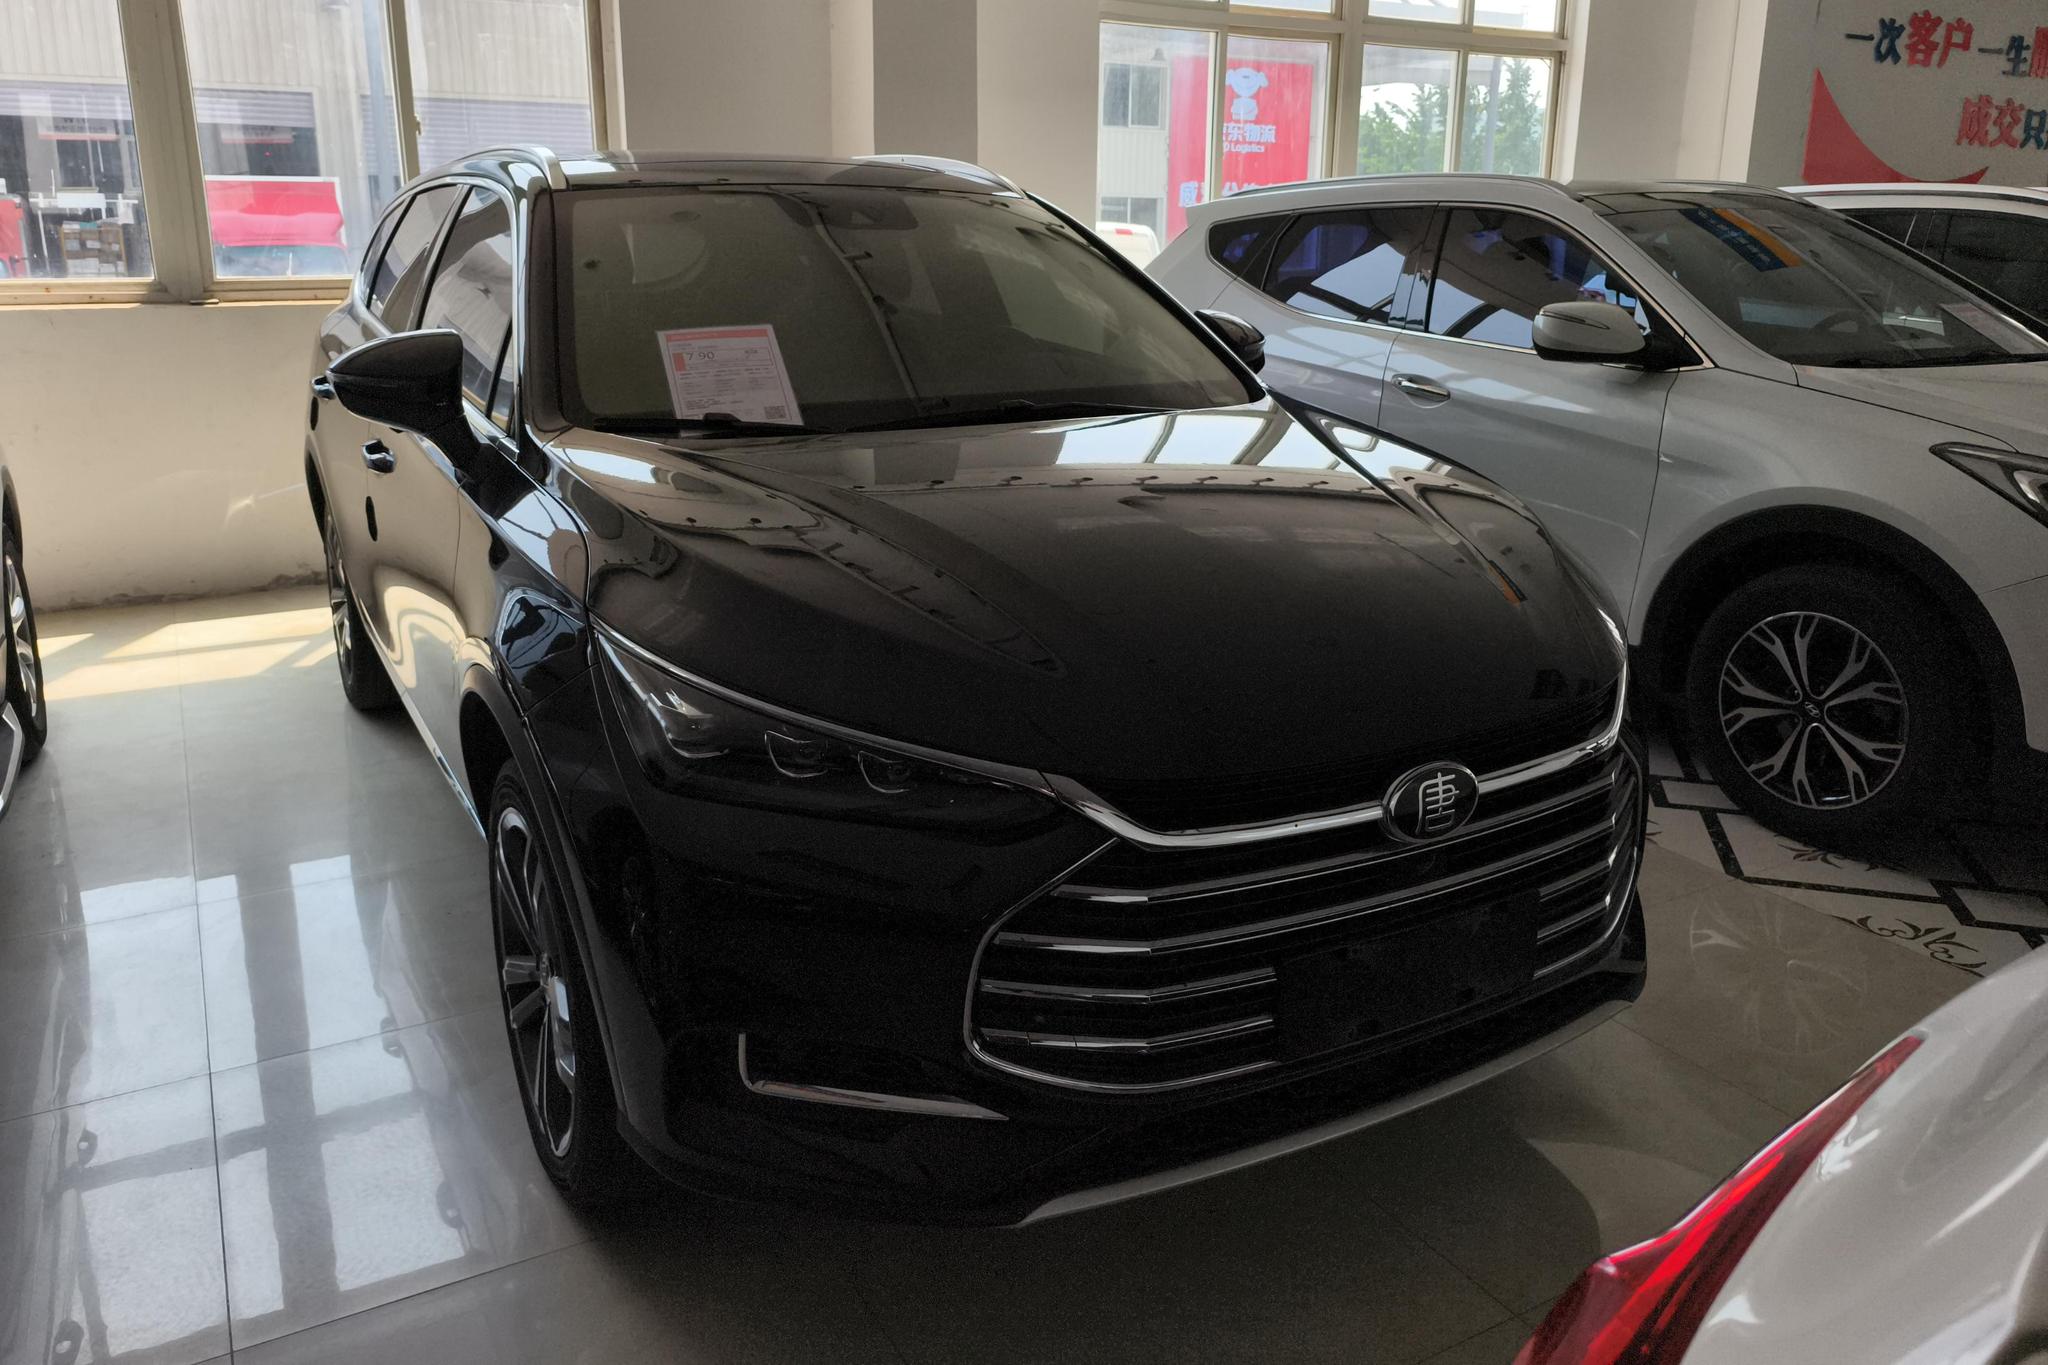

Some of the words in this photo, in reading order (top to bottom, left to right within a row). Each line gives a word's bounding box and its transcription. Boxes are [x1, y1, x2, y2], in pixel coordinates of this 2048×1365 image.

[1223, 123, 1276, 143] 东物流
[1956, 94, 2048, 150] 成交只
[1231, 143, 1265, 153] Logistics
[1415, 772, 1460, 833] 唐
